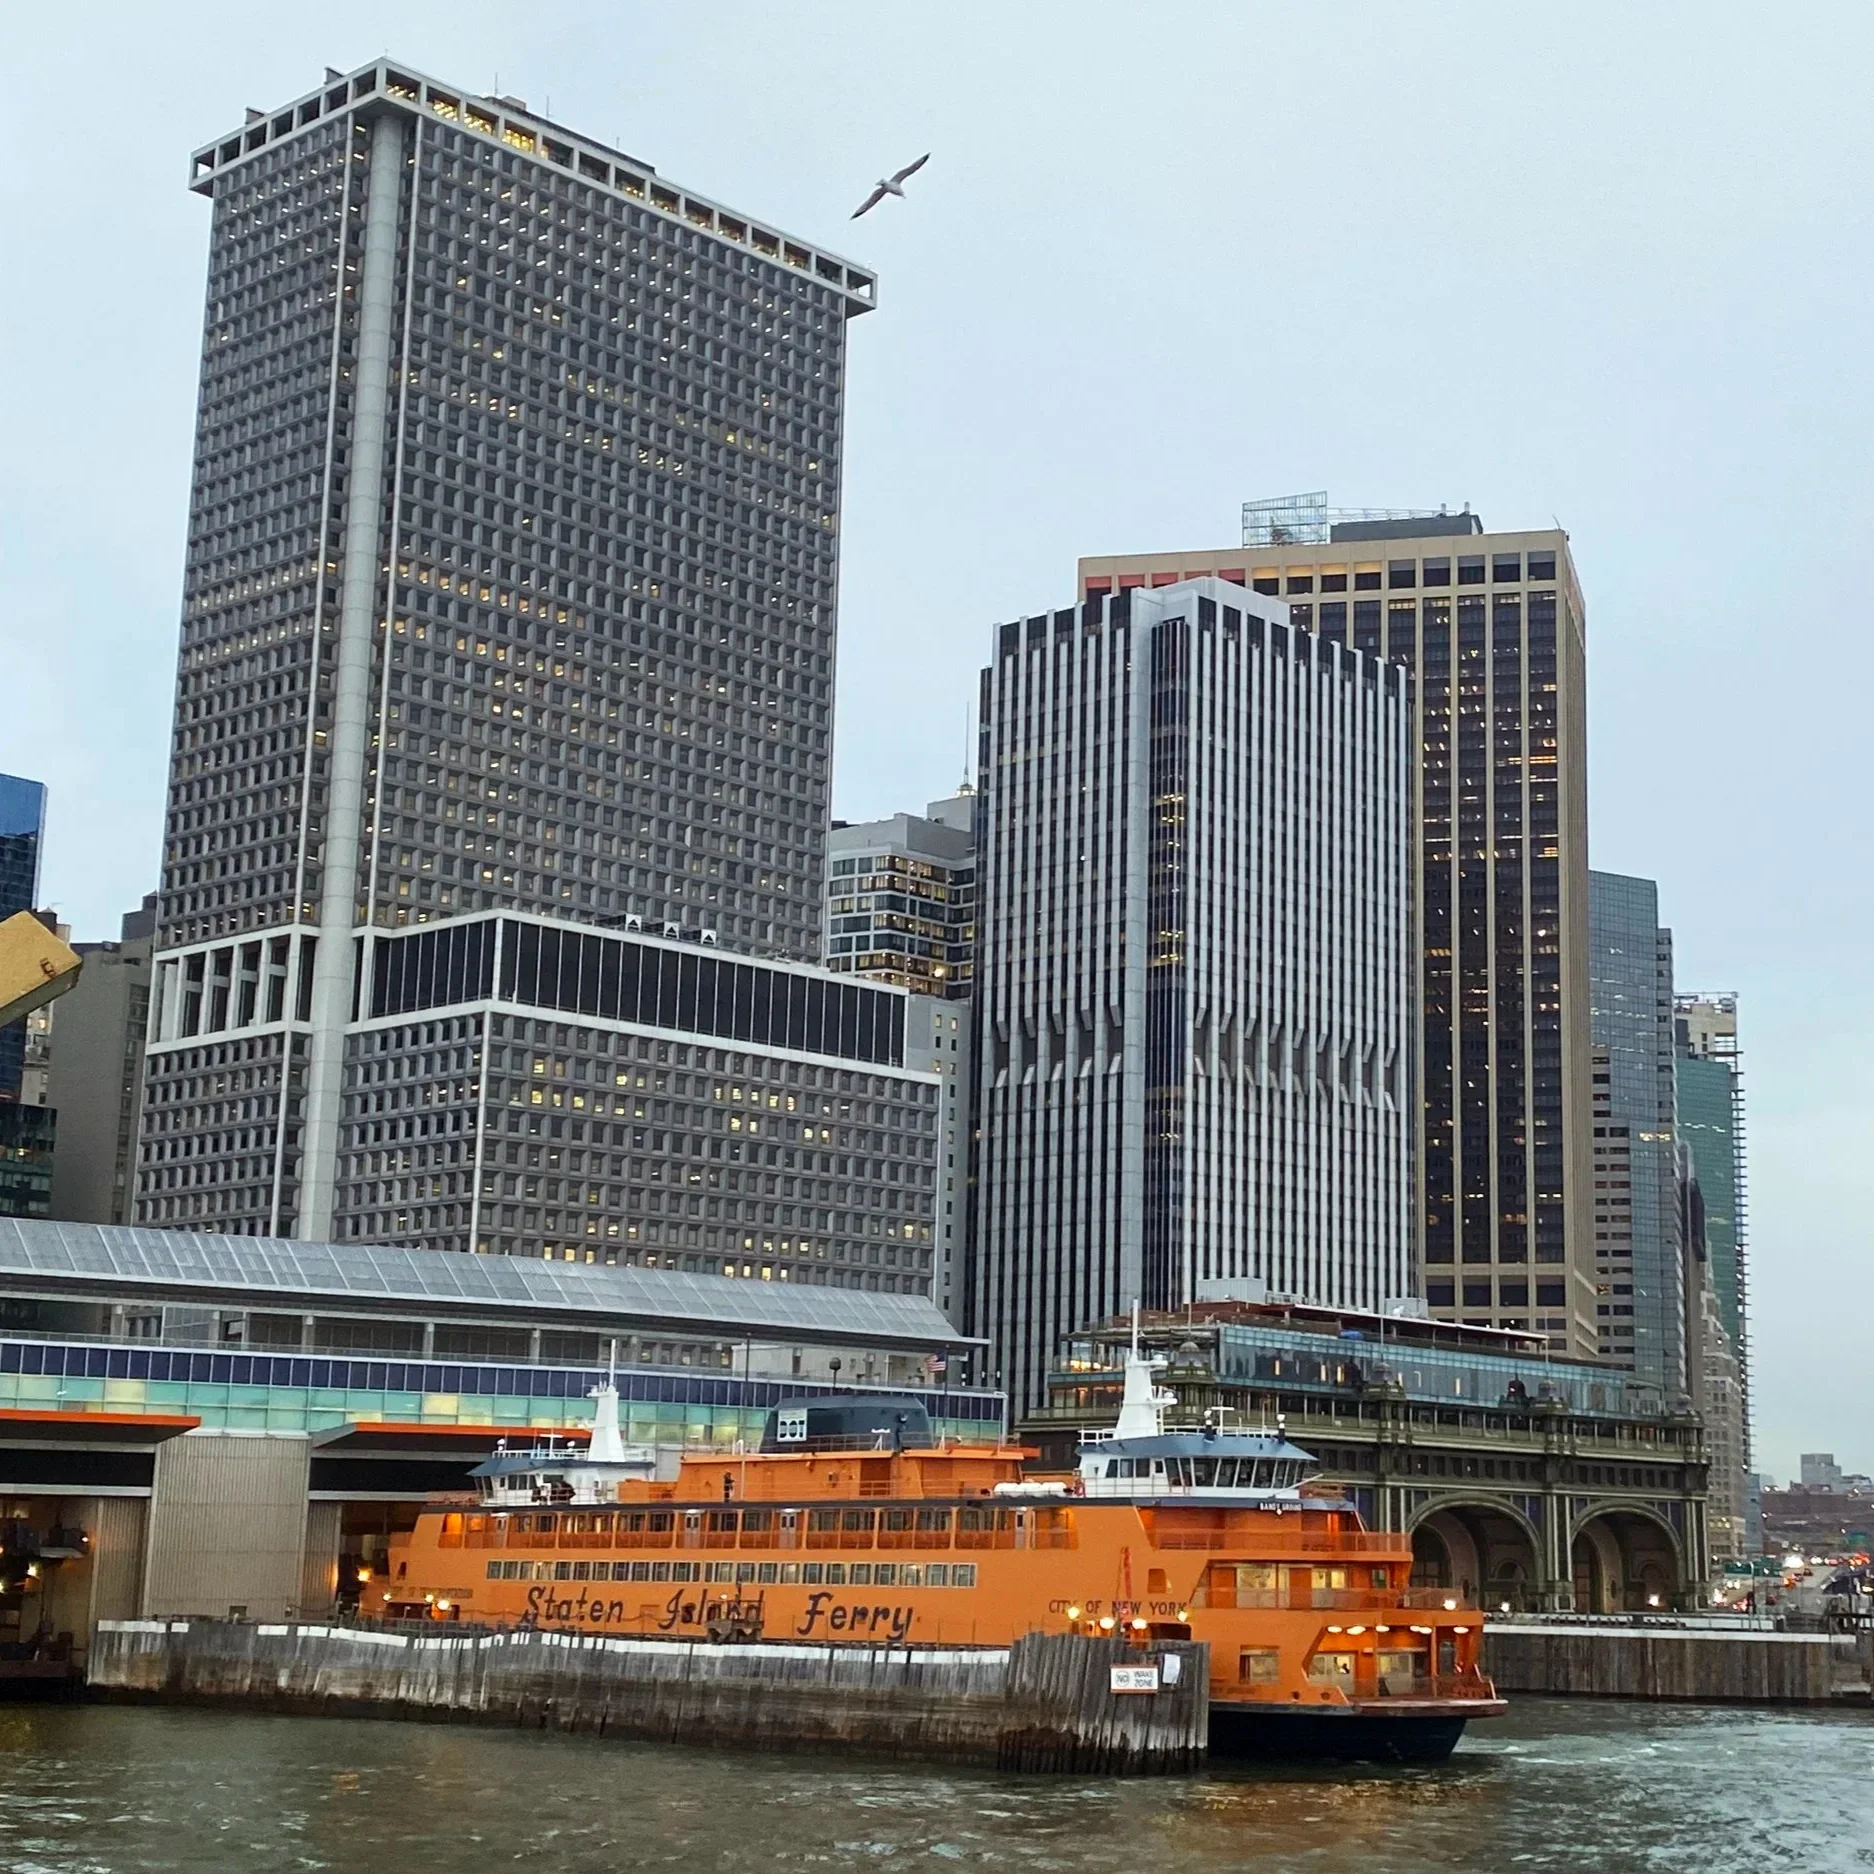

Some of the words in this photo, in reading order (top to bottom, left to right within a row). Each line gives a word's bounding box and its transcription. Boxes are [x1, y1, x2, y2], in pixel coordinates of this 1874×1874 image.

[523, 1585, 624, 1624] Staten
[657, 1588, 766, 1630] Island
[796, 1591, 914, 1640] Ferry
[1085, 1600, 1102, 1615] OF
[1111, 1600, 1142, 1618] NEW
[1149, 1601, 1188, 1616] YORK
